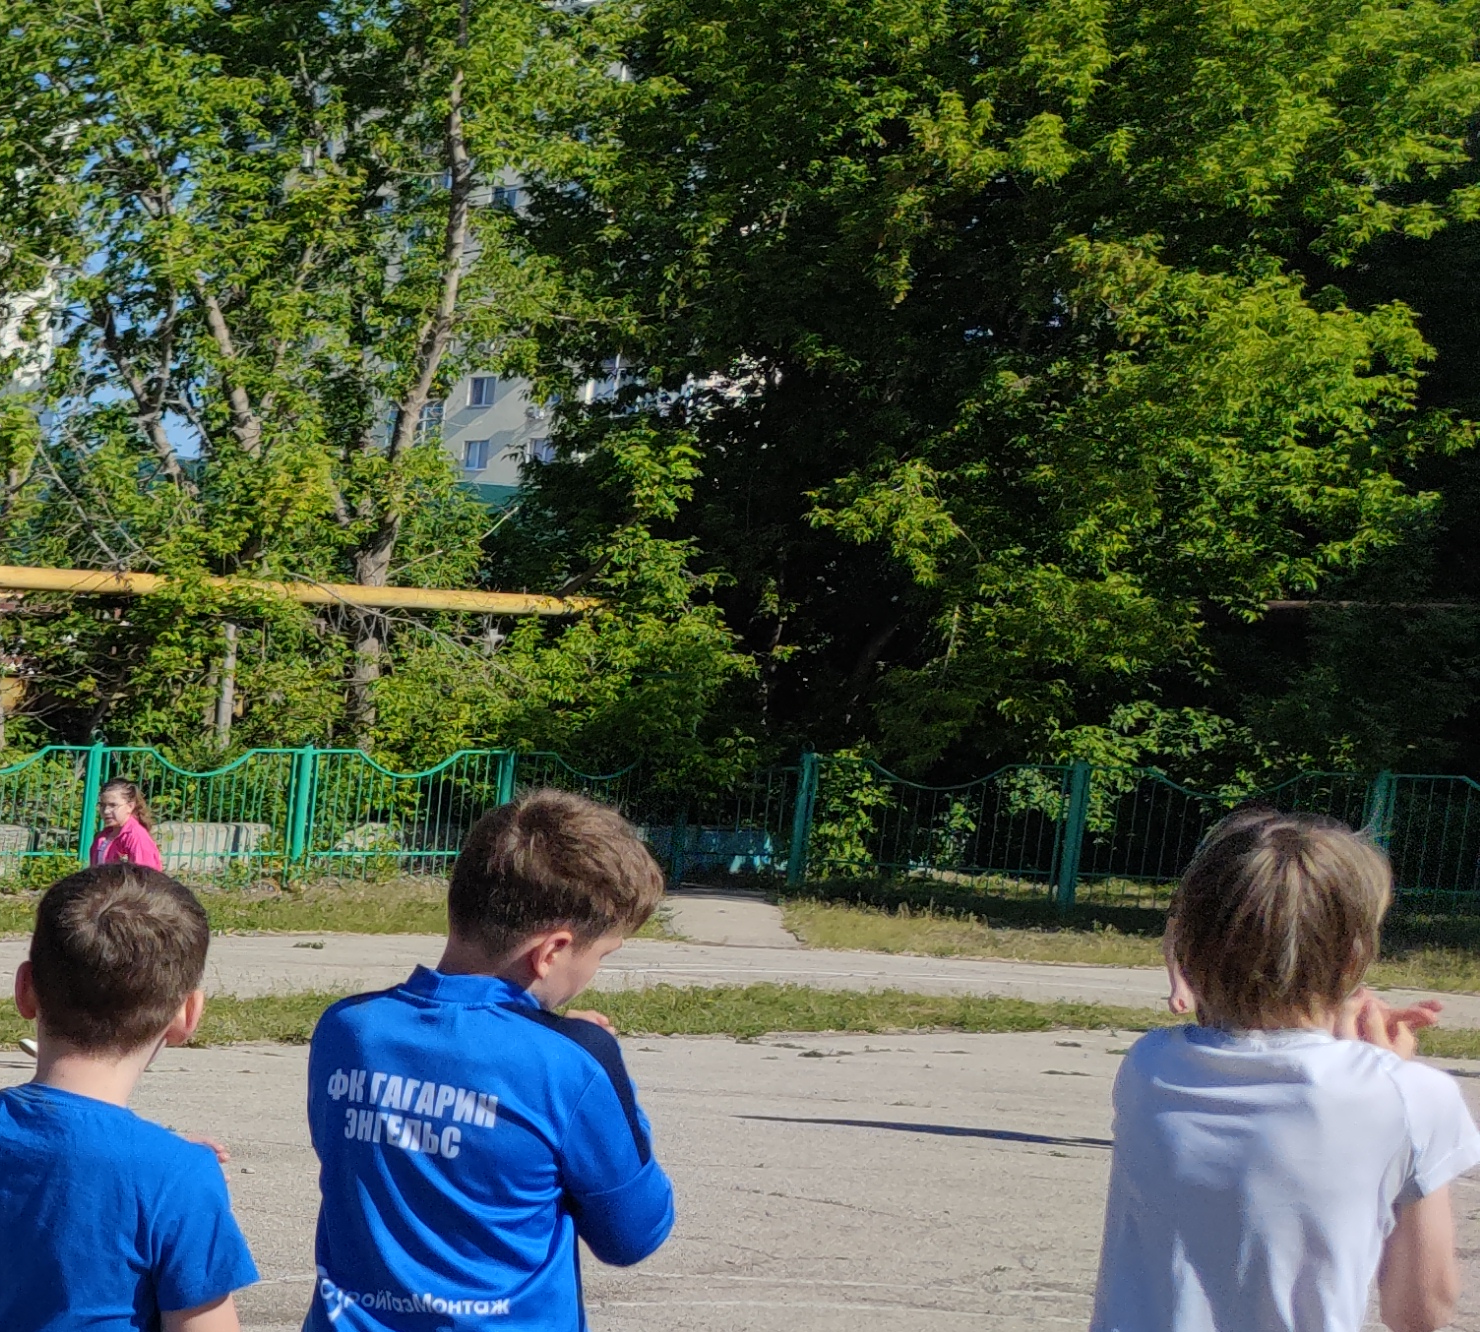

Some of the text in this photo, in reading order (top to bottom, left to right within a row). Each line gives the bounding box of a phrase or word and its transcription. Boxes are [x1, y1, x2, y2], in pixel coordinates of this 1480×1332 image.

[327, 1067, 498, 1128] ФК ГАГАРИН
[345, 1108, 461, 1159] ЭНГЕЛЬС
